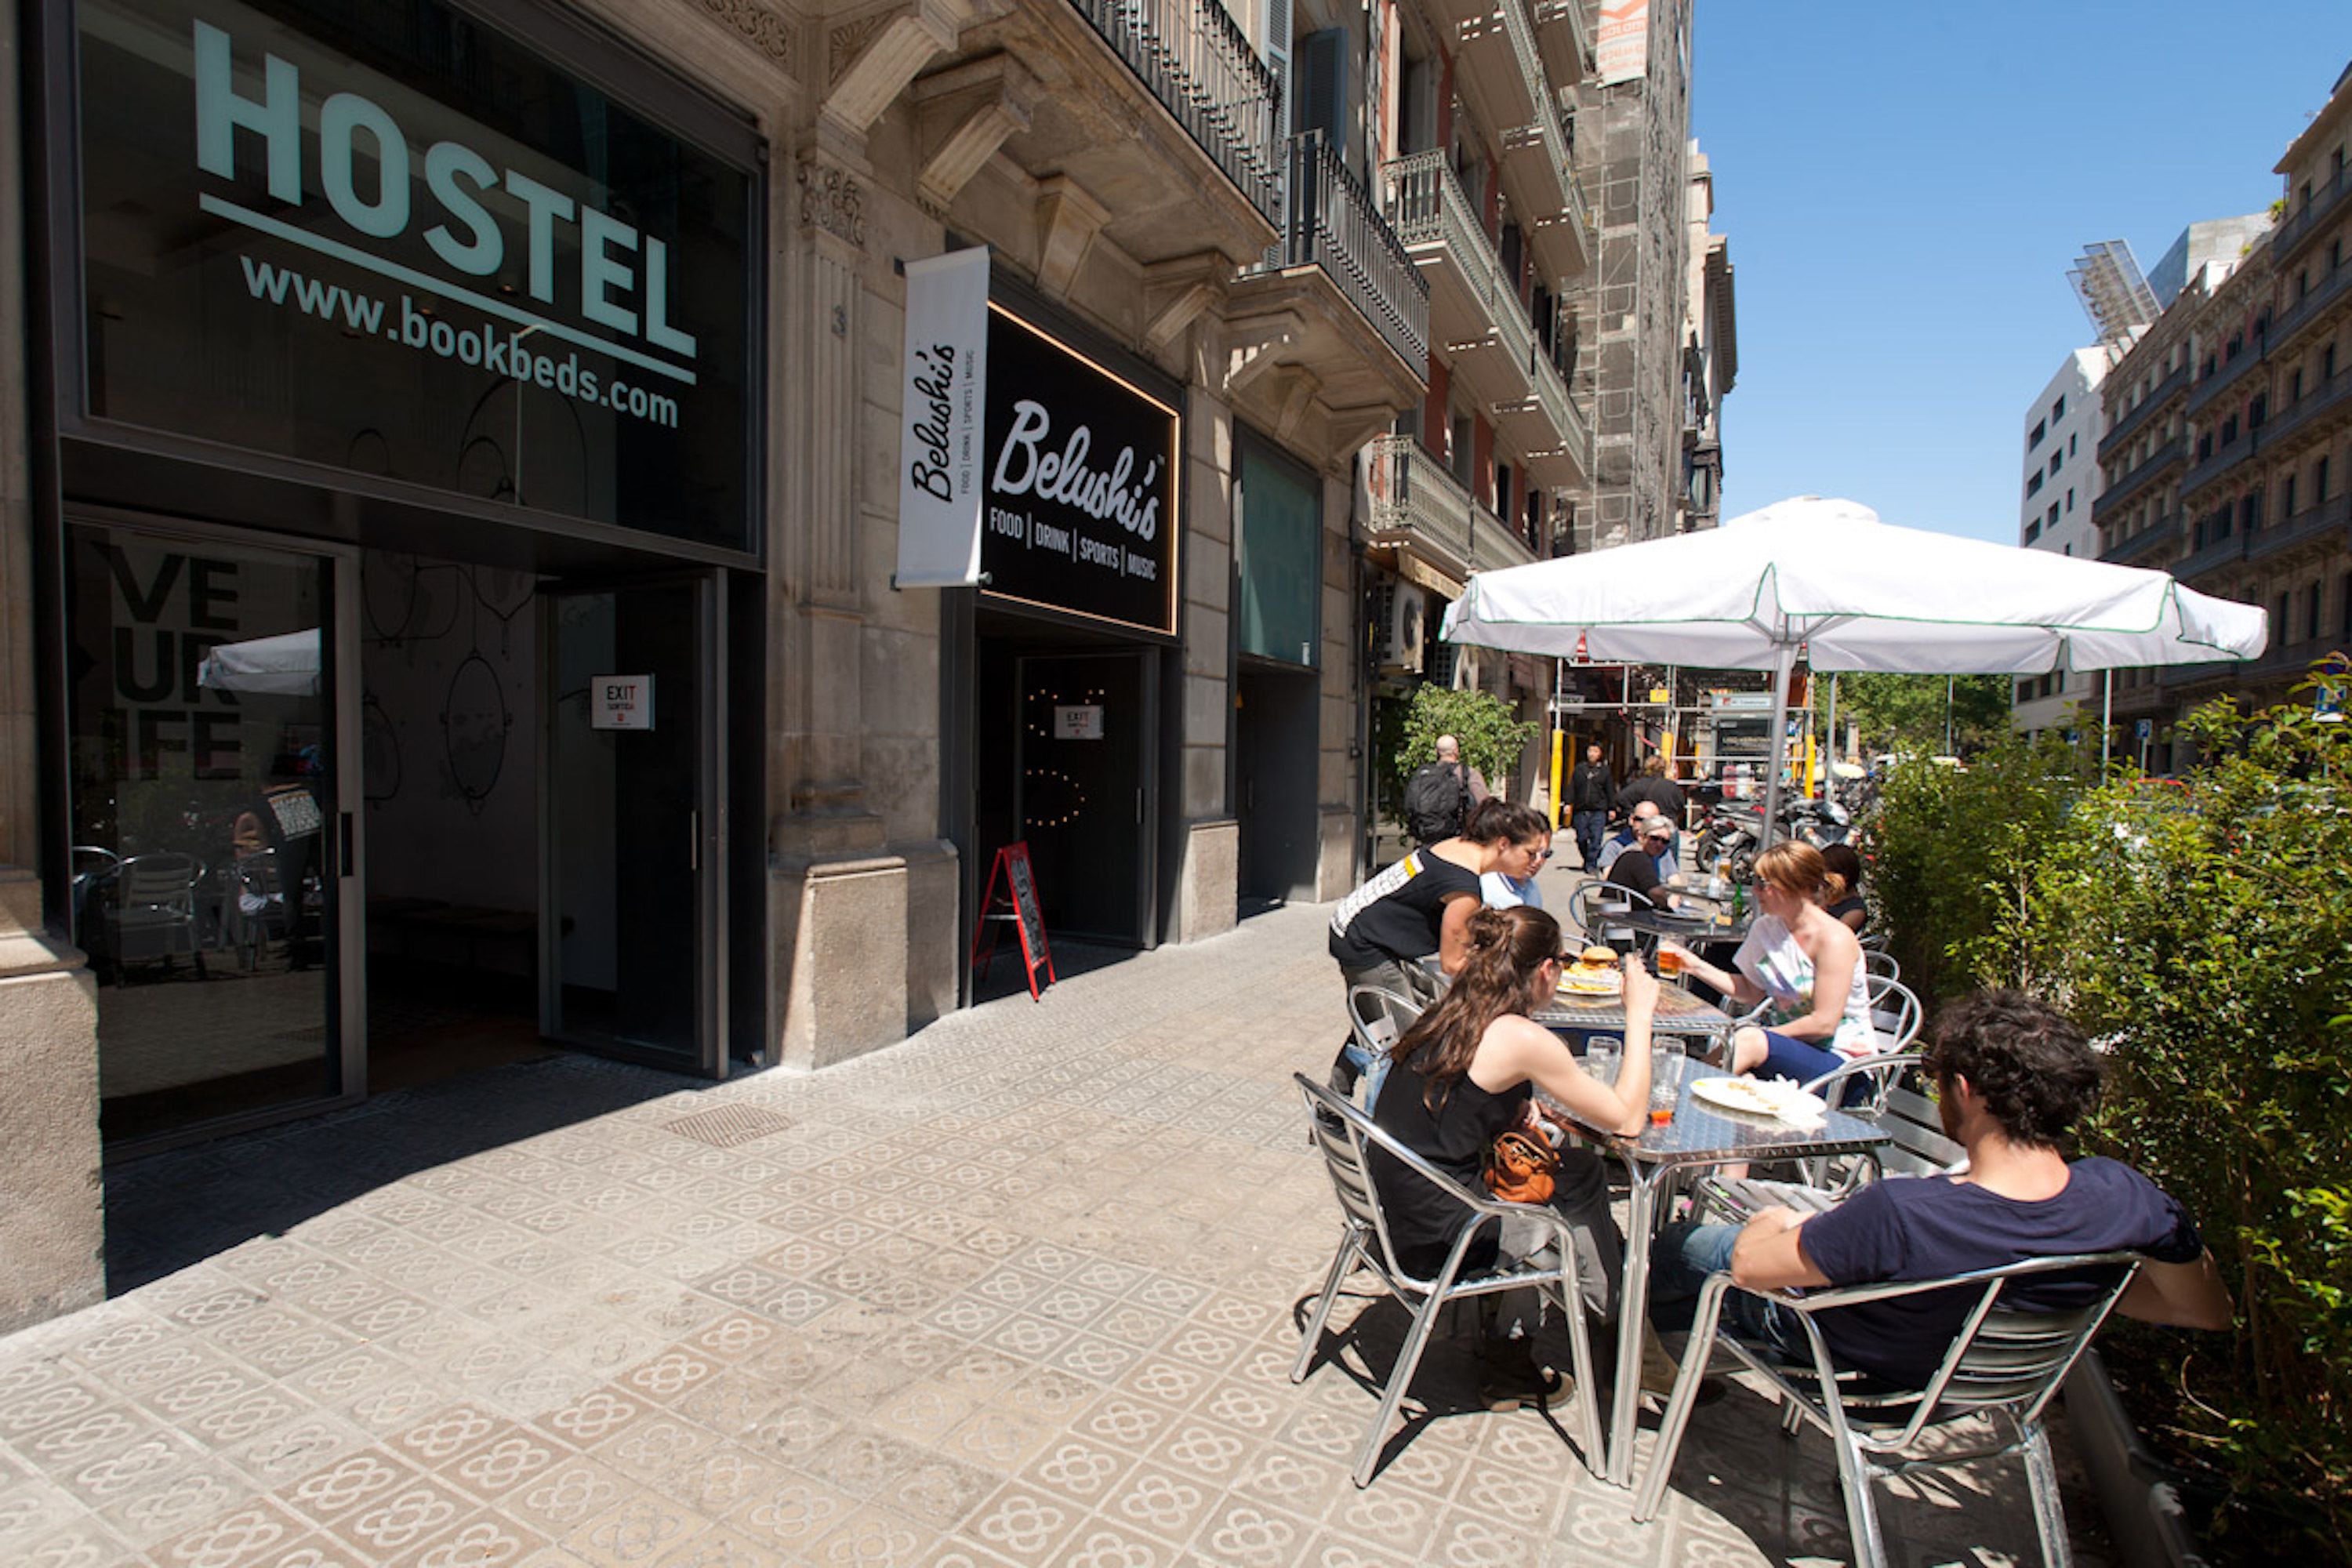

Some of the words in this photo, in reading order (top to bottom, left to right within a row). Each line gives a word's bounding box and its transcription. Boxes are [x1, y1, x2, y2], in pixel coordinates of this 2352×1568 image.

[194, 18, 697, 358] HOSTEL
[240, 254, 679, 428] www.bookbeds.com
[965, 349, 974, 379] MUSIC
[912, 344, 955, 503] Belushi's
[964, 390, 973, 424] SPORTS
[961, 434, 972, 461] DRINK
[991, 399, 1160, 542] Belushi's
[960, 470, 971, 495] FOOD
[989, 506, 1024, 539] FOOD
[1035, 522, 1070, 554] DRINK
[1080, 538, 1120, 569] SPORTS
[1127, 553, 1158, 582] MUSIC
[607, 685, 637, 700] EXIT
